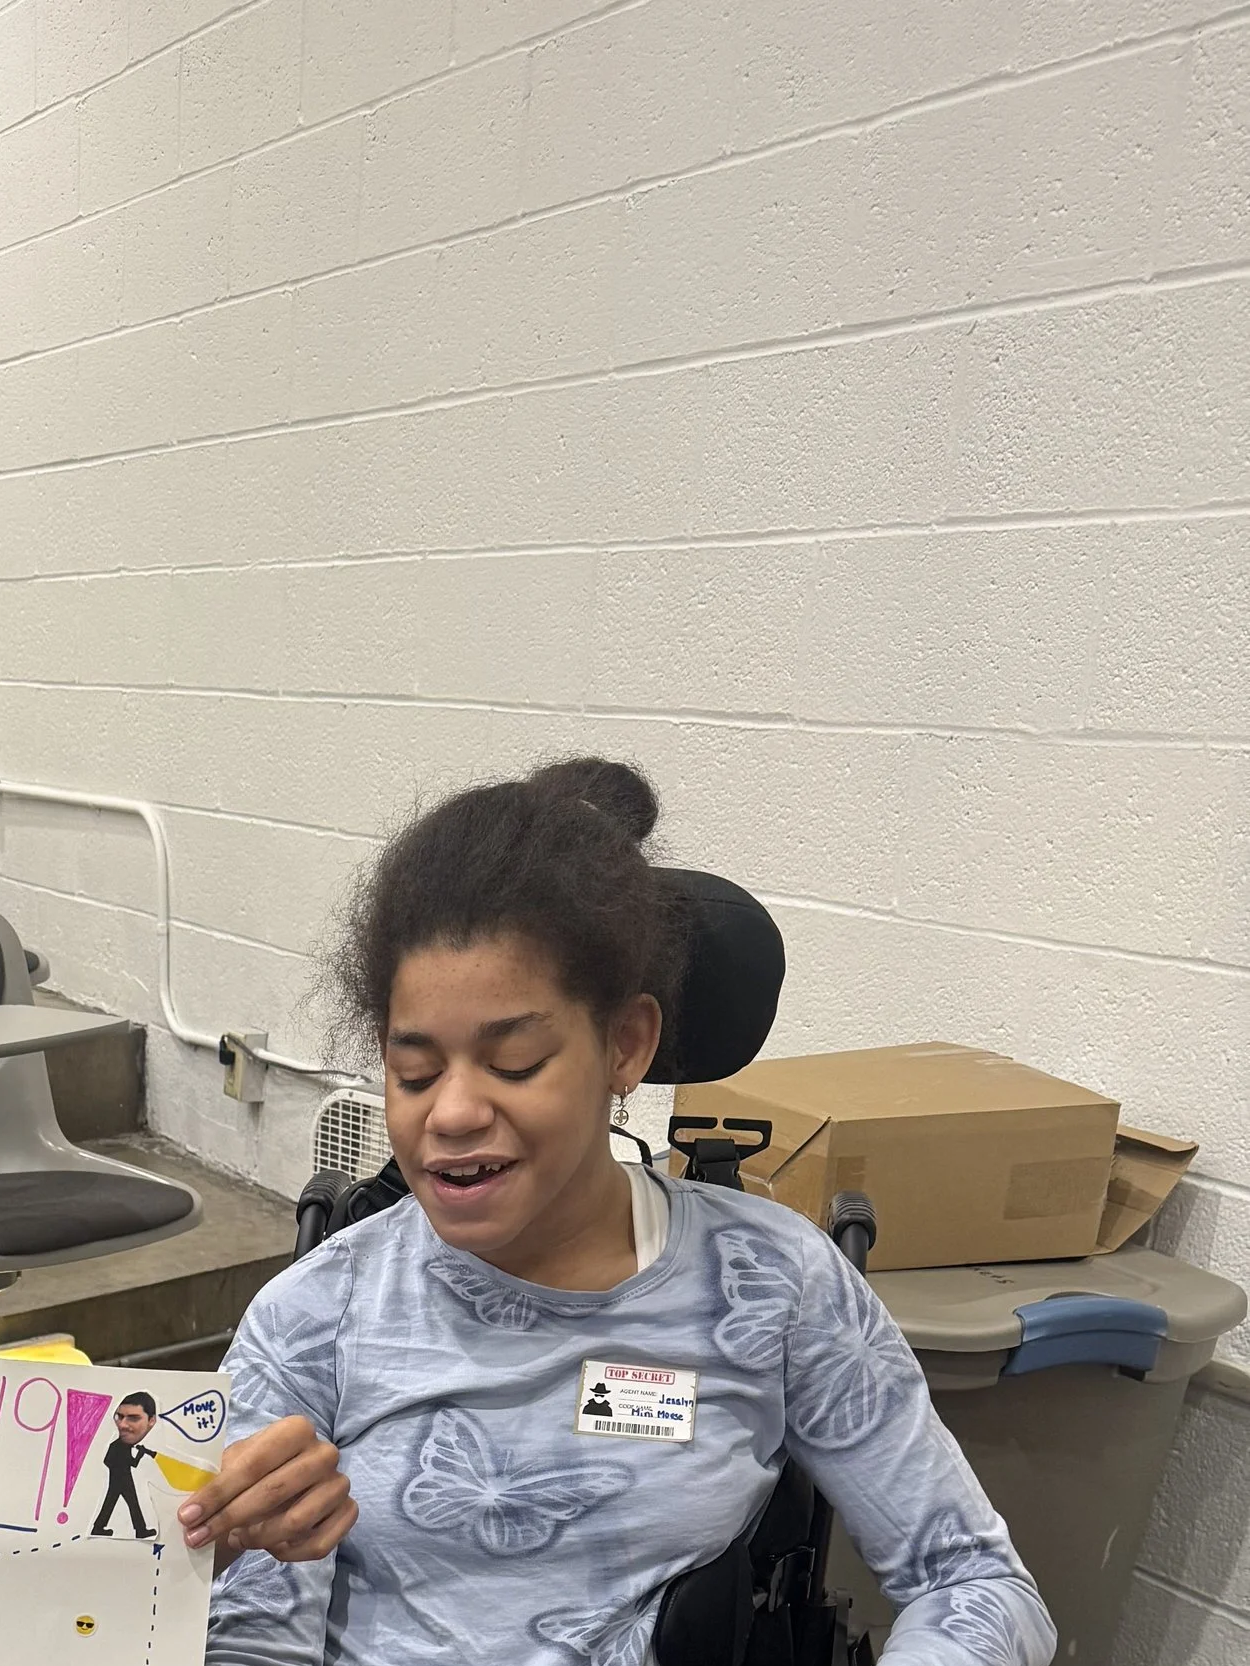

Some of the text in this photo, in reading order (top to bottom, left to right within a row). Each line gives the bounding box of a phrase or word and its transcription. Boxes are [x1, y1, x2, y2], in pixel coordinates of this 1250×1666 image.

[608, 1368, 672, 1382] TOP SECRET
[183, 1400, 216, 1416] Move
[196, 1415, 216, 1429] it!
